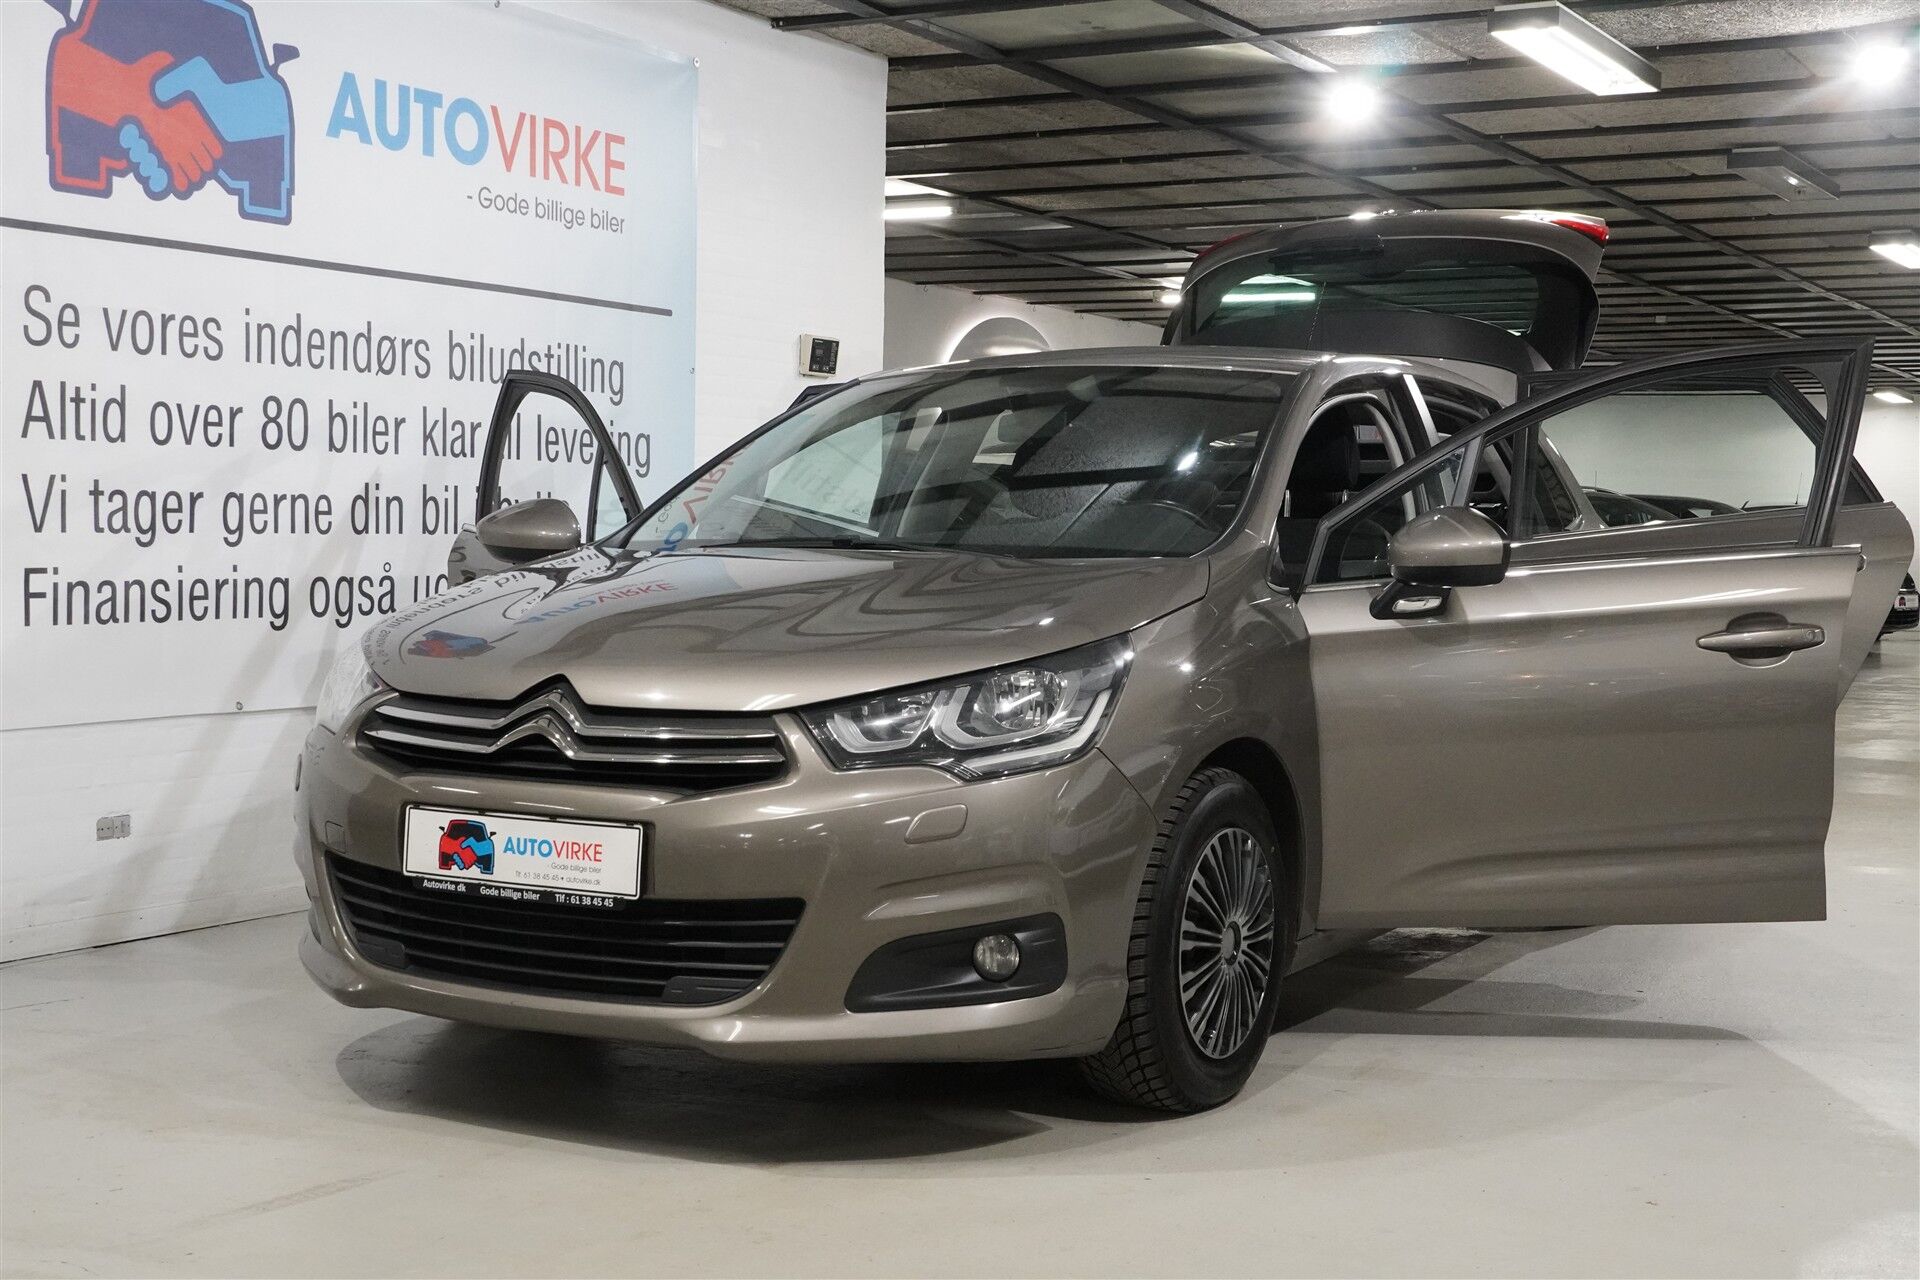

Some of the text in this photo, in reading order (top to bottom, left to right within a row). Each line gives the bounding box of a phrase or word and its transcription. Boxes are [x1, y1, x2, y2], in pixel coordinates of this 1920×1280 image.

[325, 71, 626, 197] AUTOVIRKE
[478, 186, 530, 217] Gode
[534, 193, 585, 230] billige
[590, 203, 626, 235] biler
[22, 283, 625, 407] Se vores indendørs biludstilling
[21, 379, 127, 444] Altid
[149, 404, 244, 448] over
[261, 395, 309, 452] 80
[328, 400, 406, 456] biler
[422, 407, 483, 462] klar
[537, 414, 651, 479] leveing
[21, 473, 68, 534] Vi
[90, 478, 204, 546] tager
[222, 491, 333, 546] gerne
[350, 483, 404, 537] din
[422, 483, 459, 536] bil
[23, 564, 290, 631] Finansiering
[309, 561, 397, 629] også
[503, 836, 603, 863] AUTOVIRKE
[423, 879, 456, 891] Autovirke
[480, 887, 540, 901] Gode billige biler
[571, 895, 580, 904] 61
[581, 896, 591, 905] 38
[592, 897, 602, 906] 45
[603, 898, 613, 908] 45
